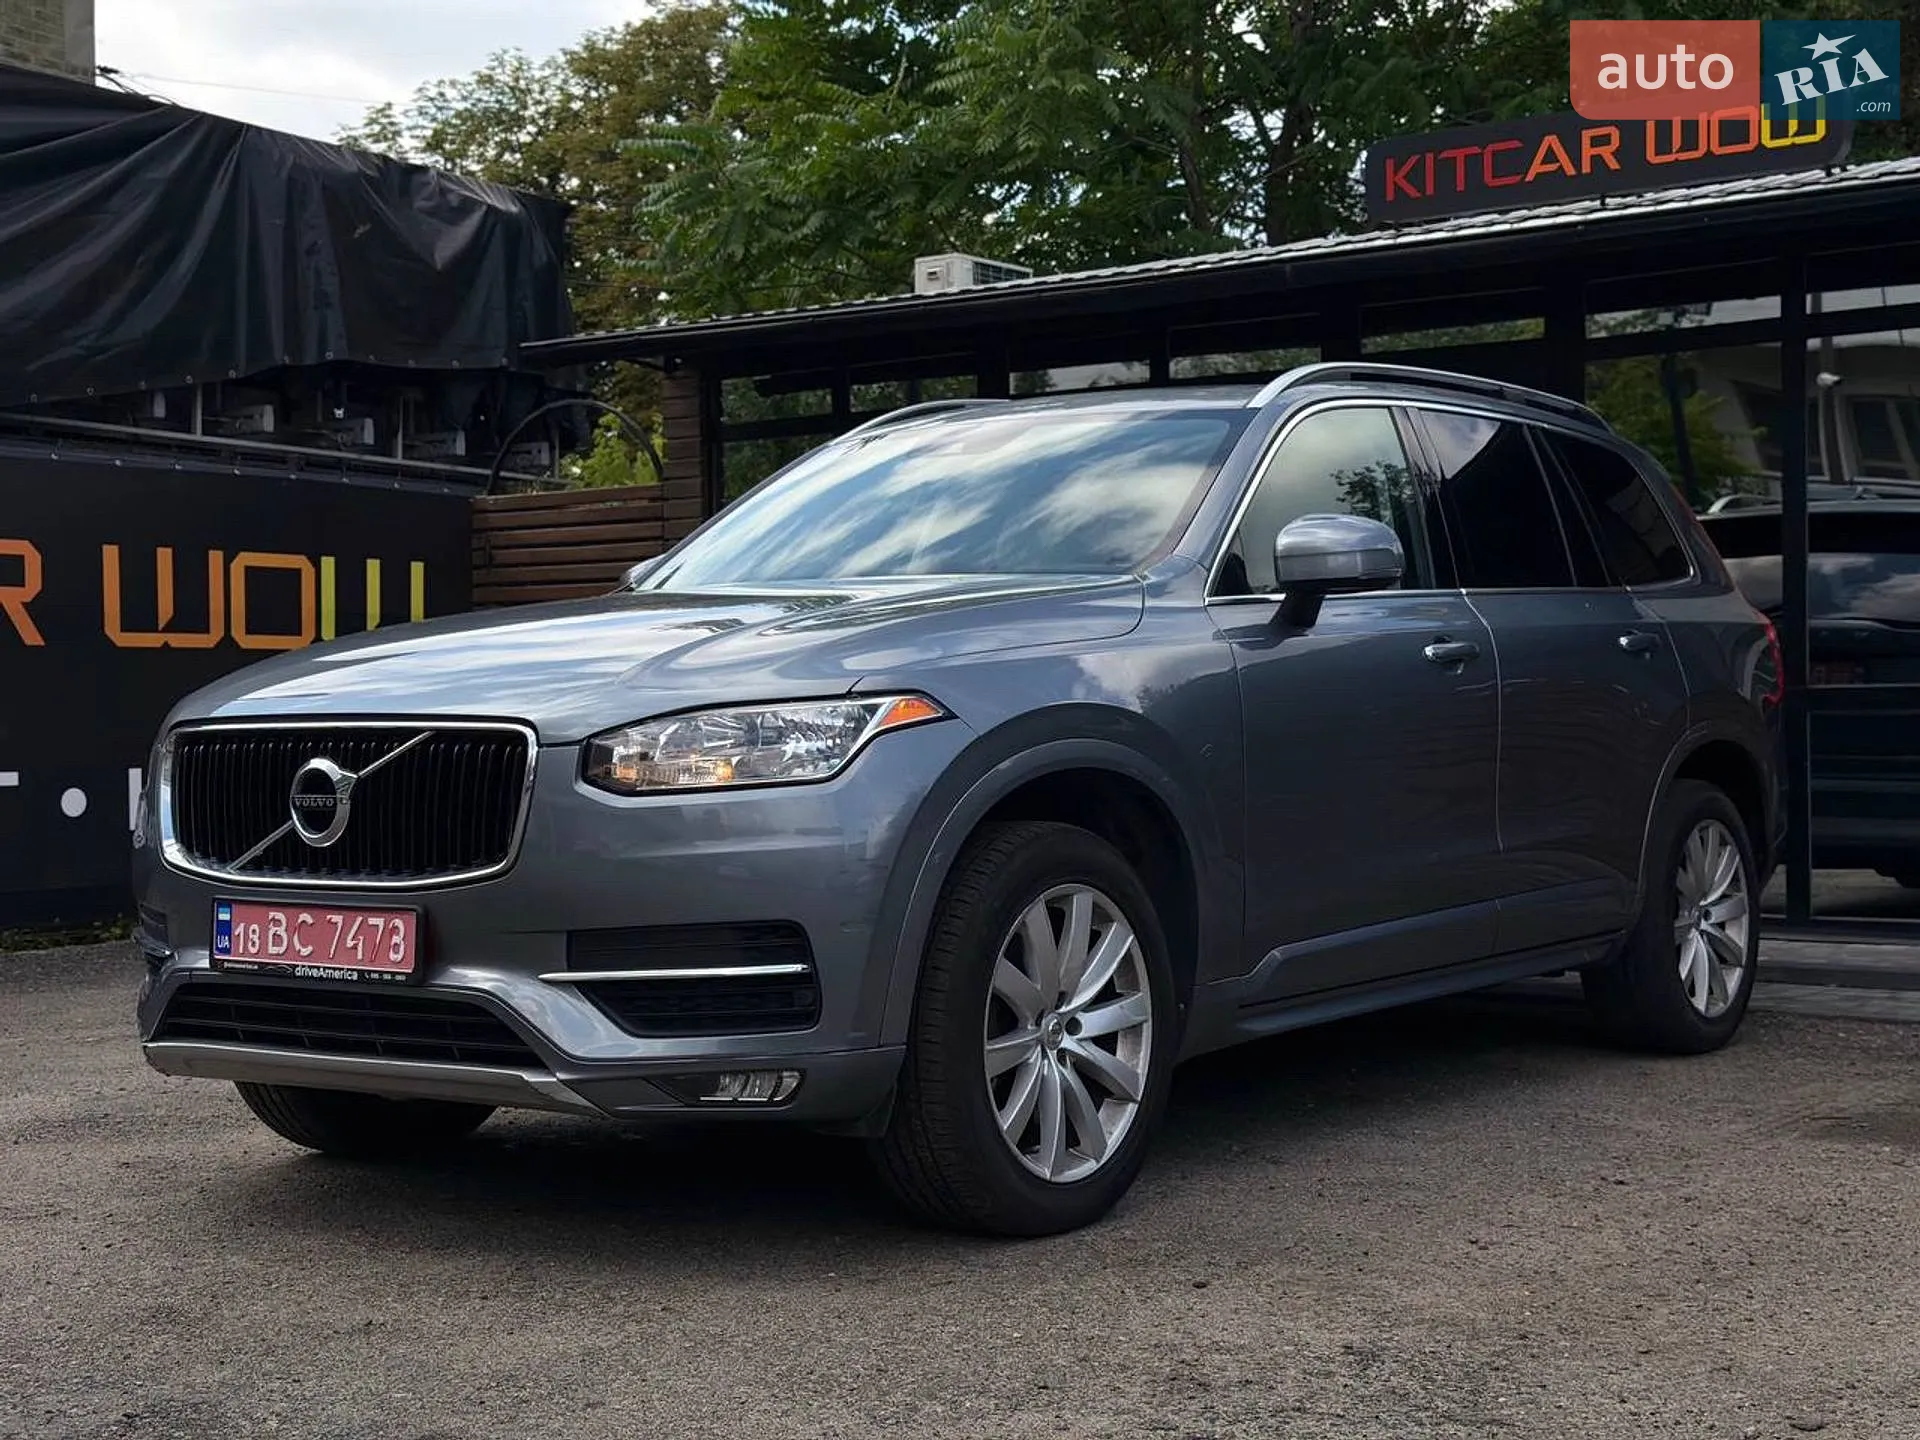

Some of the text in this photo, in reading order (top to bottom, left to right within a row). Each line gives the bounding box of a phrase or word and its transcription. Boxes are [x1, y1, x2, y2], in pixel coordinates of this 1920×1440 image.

[1385, 96, 1826, 202] KITCAR WOW
[102, 544, 424, 649] WOW
[295, 798, 334, 807] VOLVO
[217, 935, 230, 949] UA
[234, 922, 260, 954] 18
[267, 911, 316, 957] BC
[294, 966, 358, 981] driveAmerica
